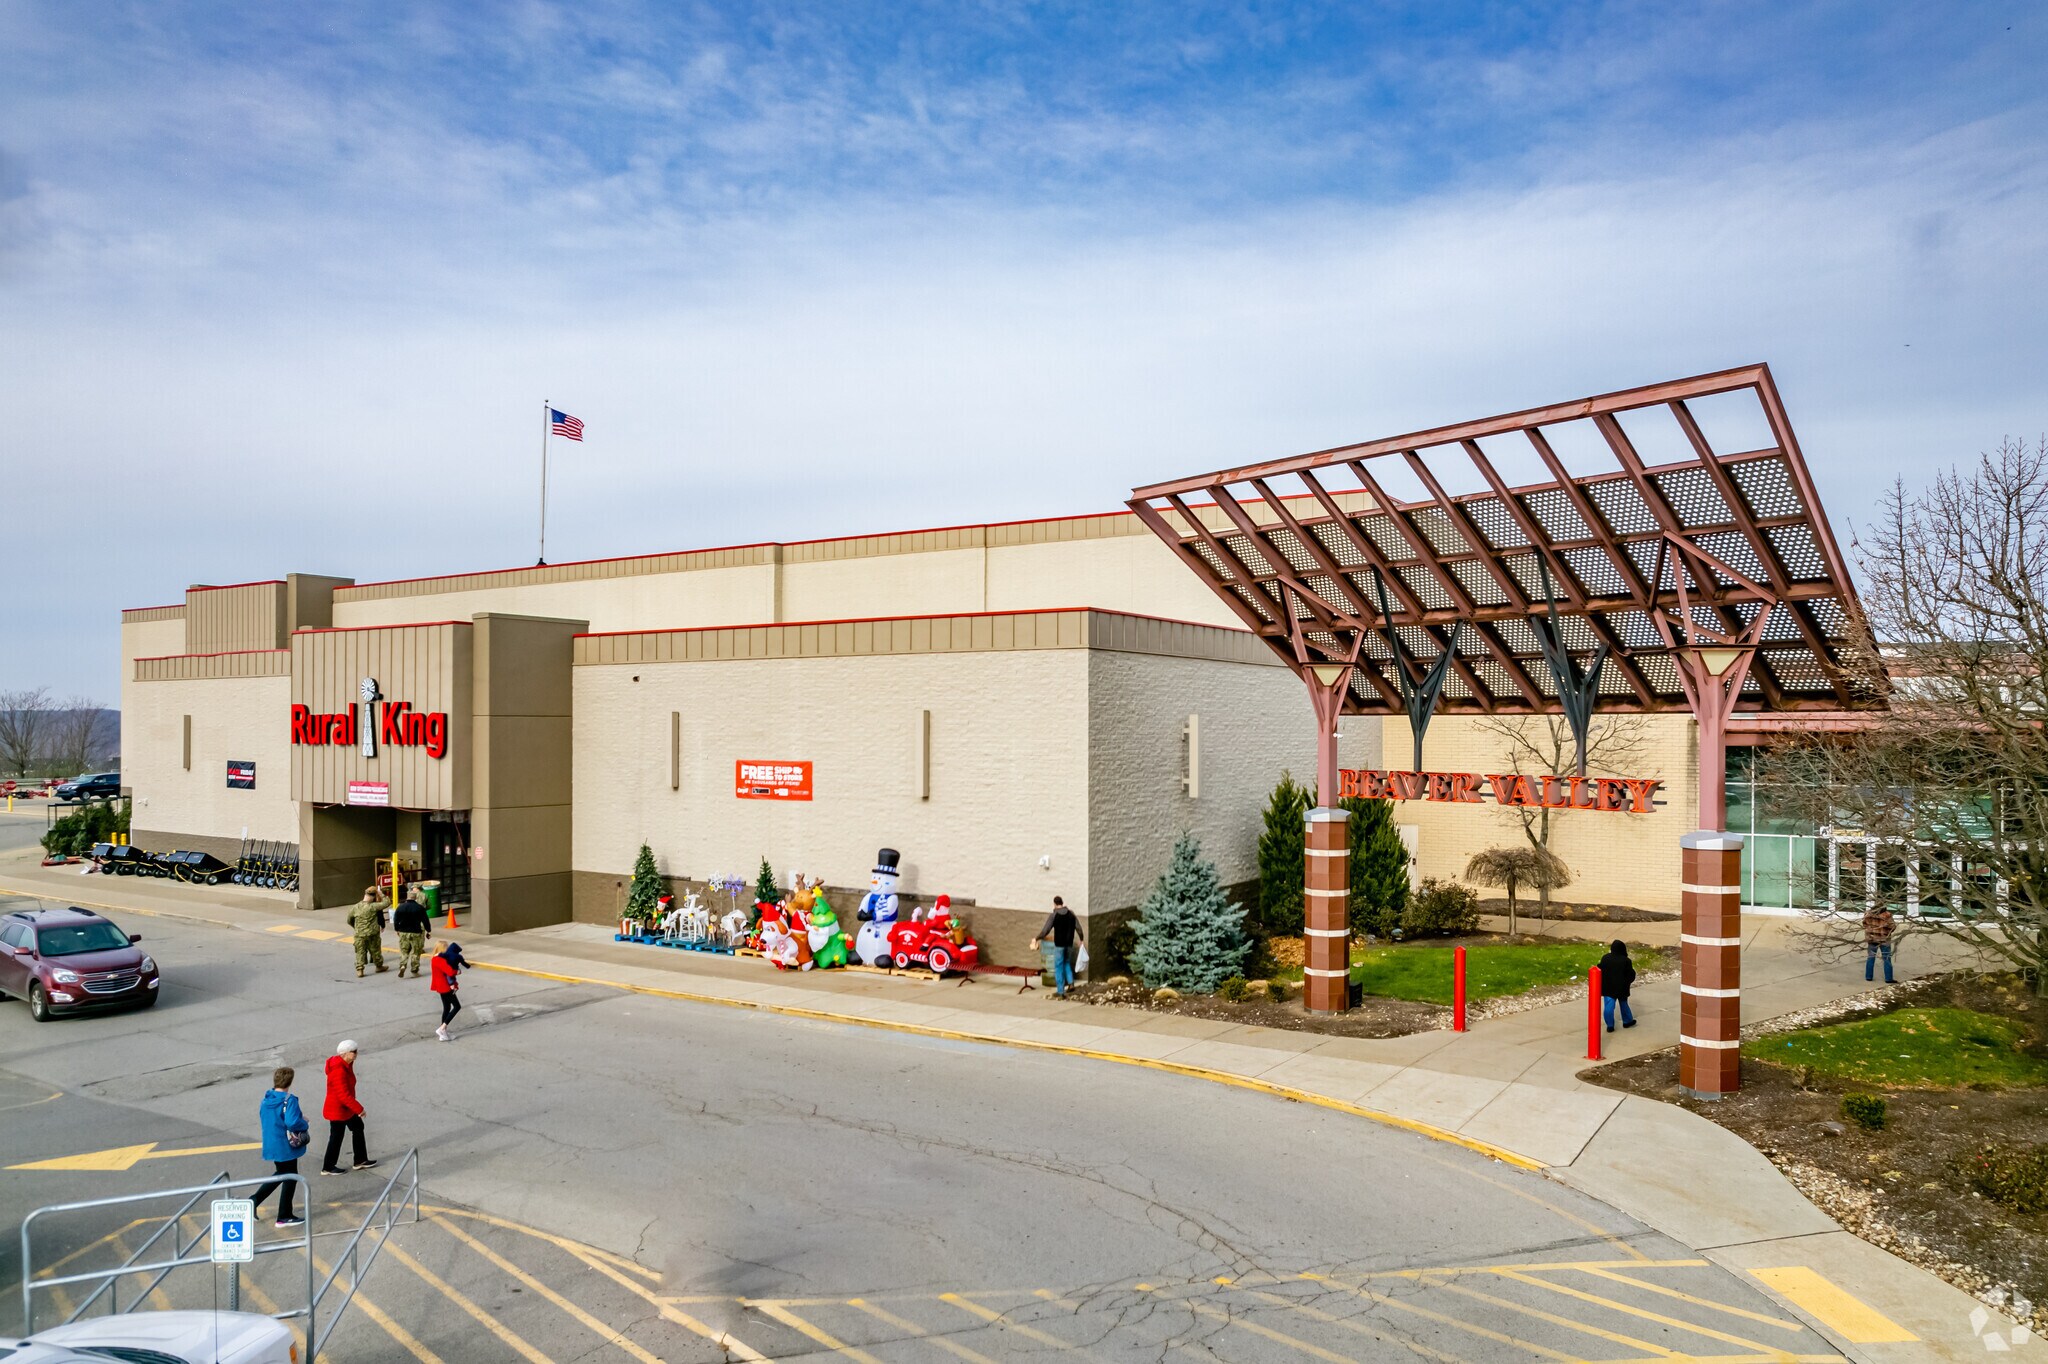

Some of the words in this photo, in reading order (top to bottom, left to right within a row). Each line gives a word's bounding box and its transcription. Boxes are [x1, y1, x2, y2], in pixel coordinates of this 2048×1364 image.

[291, 703, 357, 745] Rural
[382, 701, 445, 758] King
[741, 764, 774, 780] FREE
[774, 766, 792, 774] SHIP
[783, 774, 803, 782] STORE
[1337, 768, 1486, 803] BEAVER
[1484, 774, 1665, 813] VALLEY
